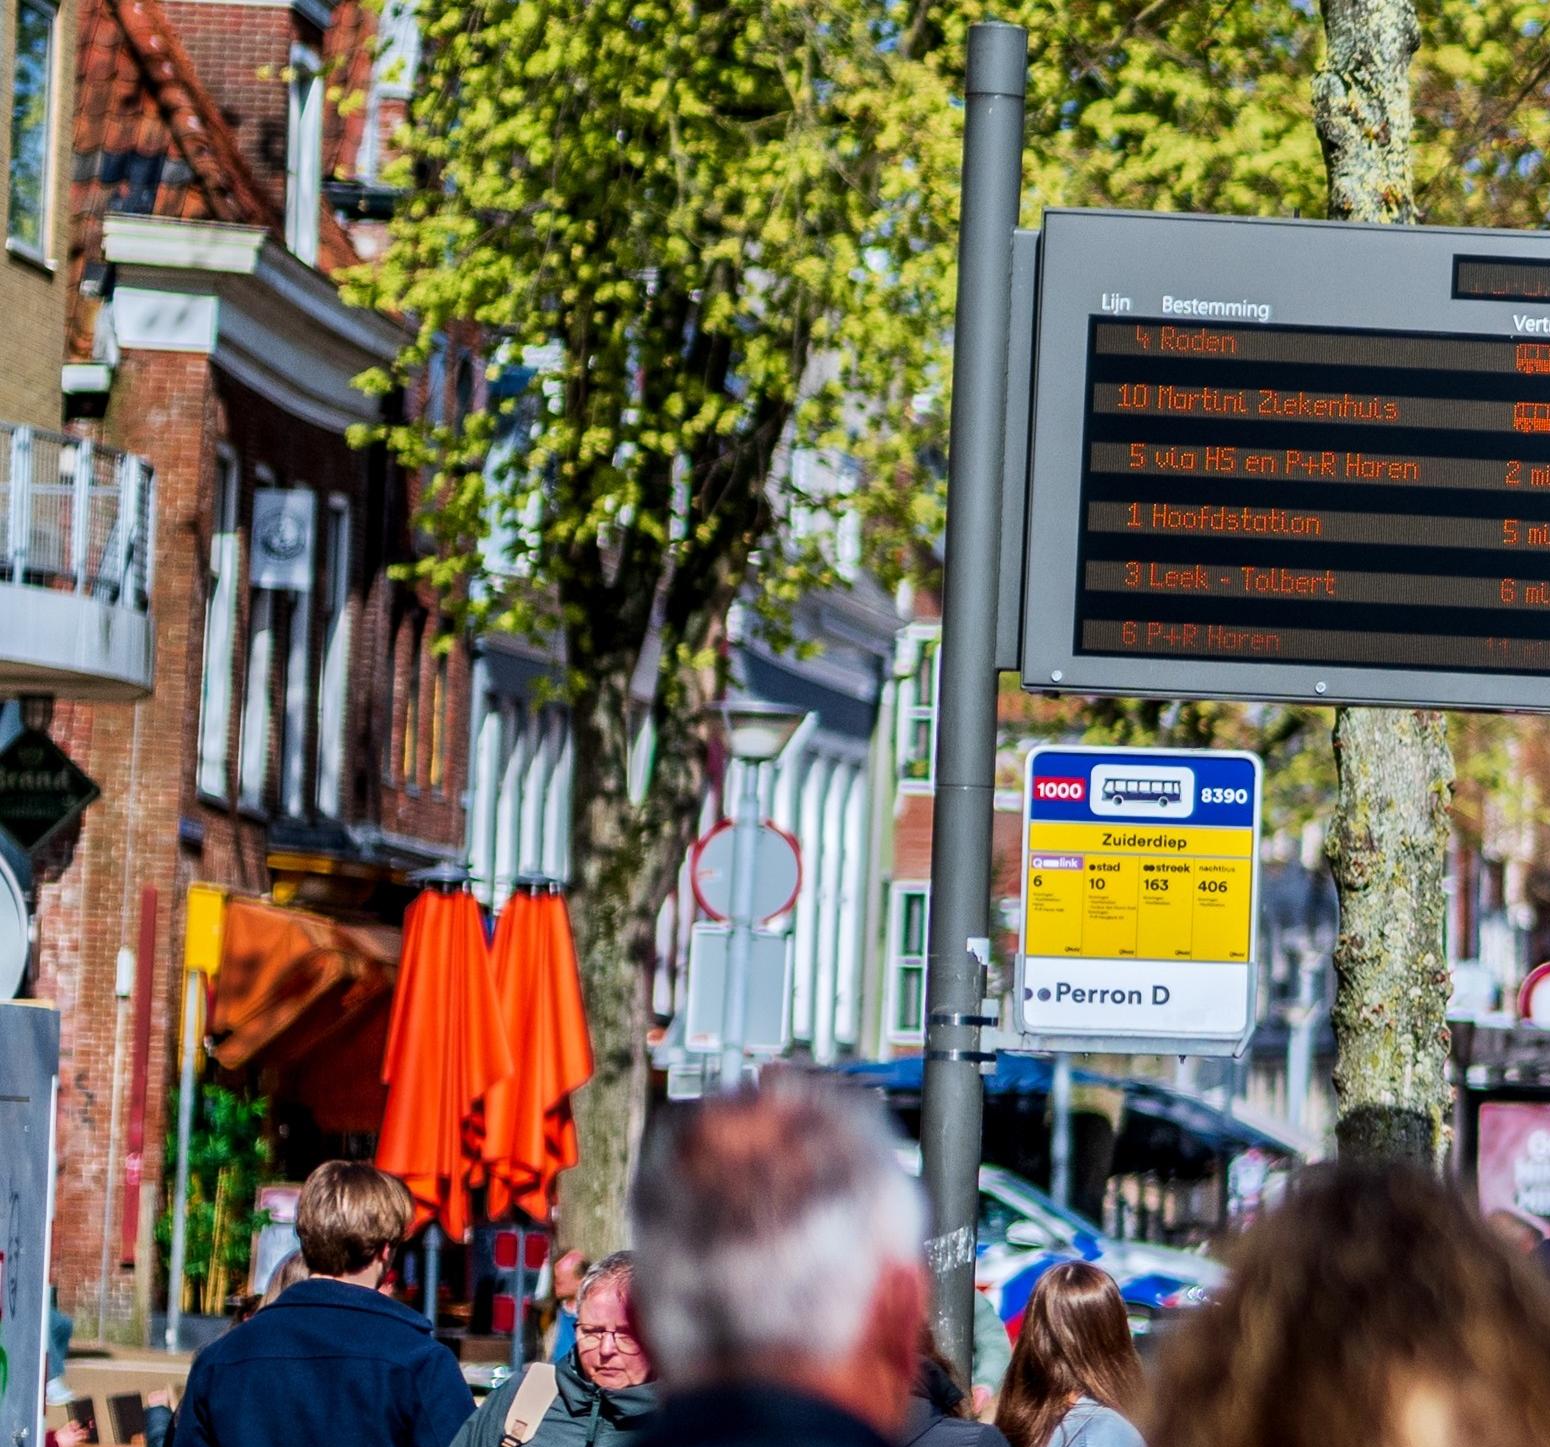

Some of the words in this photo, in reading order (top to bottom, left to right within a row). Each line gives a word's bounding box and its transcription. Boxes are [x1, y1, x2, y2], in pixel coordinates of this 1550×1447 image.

[1101, 293, 1131, 314] Lijn
[1162, 295, 1271, 321] Bestemming
[1135, 324, 1150, 349] 4
[1160, 326, 1237, 353] Roden
[1118, 383, 1148, 409] 10
[1157, 385, 1248, 414] Martini
[1258, 389, 1398, 421] Ziekenhuis
[1130, 443, 1146, 469] 5
[1155, 447, 1195, 469] via
[1206, 447, 1237, 471] HS
[1245, 454, 1275, 473] en
[1286, 449, 1335, 476] P+R
[1345, 453, 1418, 480] Haren
[1504, 461, 1521, 486] 2
[1127, 502, 1142, 528] 1
[1152, 503, 1321, 535] Hoofdstation
[1503, 519, 1519, 545] 5
[1125, 561, 1141, 587] 3
[1150, 562, 1208, 589] Leek
[1241, 566, 1335, 594] Tolbert
[1500, 578, 1516, 603] 6
[1121, 620, 1137, 645] 6
[1147, 622, 1198, 648] P+R
[1207, 624, 1281, 652] Haren
[1036, 781, 1083, 800] 1000
[1200, 787, 1248, 805] 8390
[1101, 832, 1188, 850] Zuiderdiep
[1096, 861, 1121, 872] stad
[1156, 863, 1191, 873] streek
[1199, 865, 1236, 873] nachtbus
[1033, 875, 1043, 888] 6
[1089, 878, 1106, 891] 10
[1143, 878, 1169, 891] 163
[1198, 880, 1228, 893] 406
[1056, 981, 1143, 1005] Perron
[1151, 984, 1171, 1006] D
